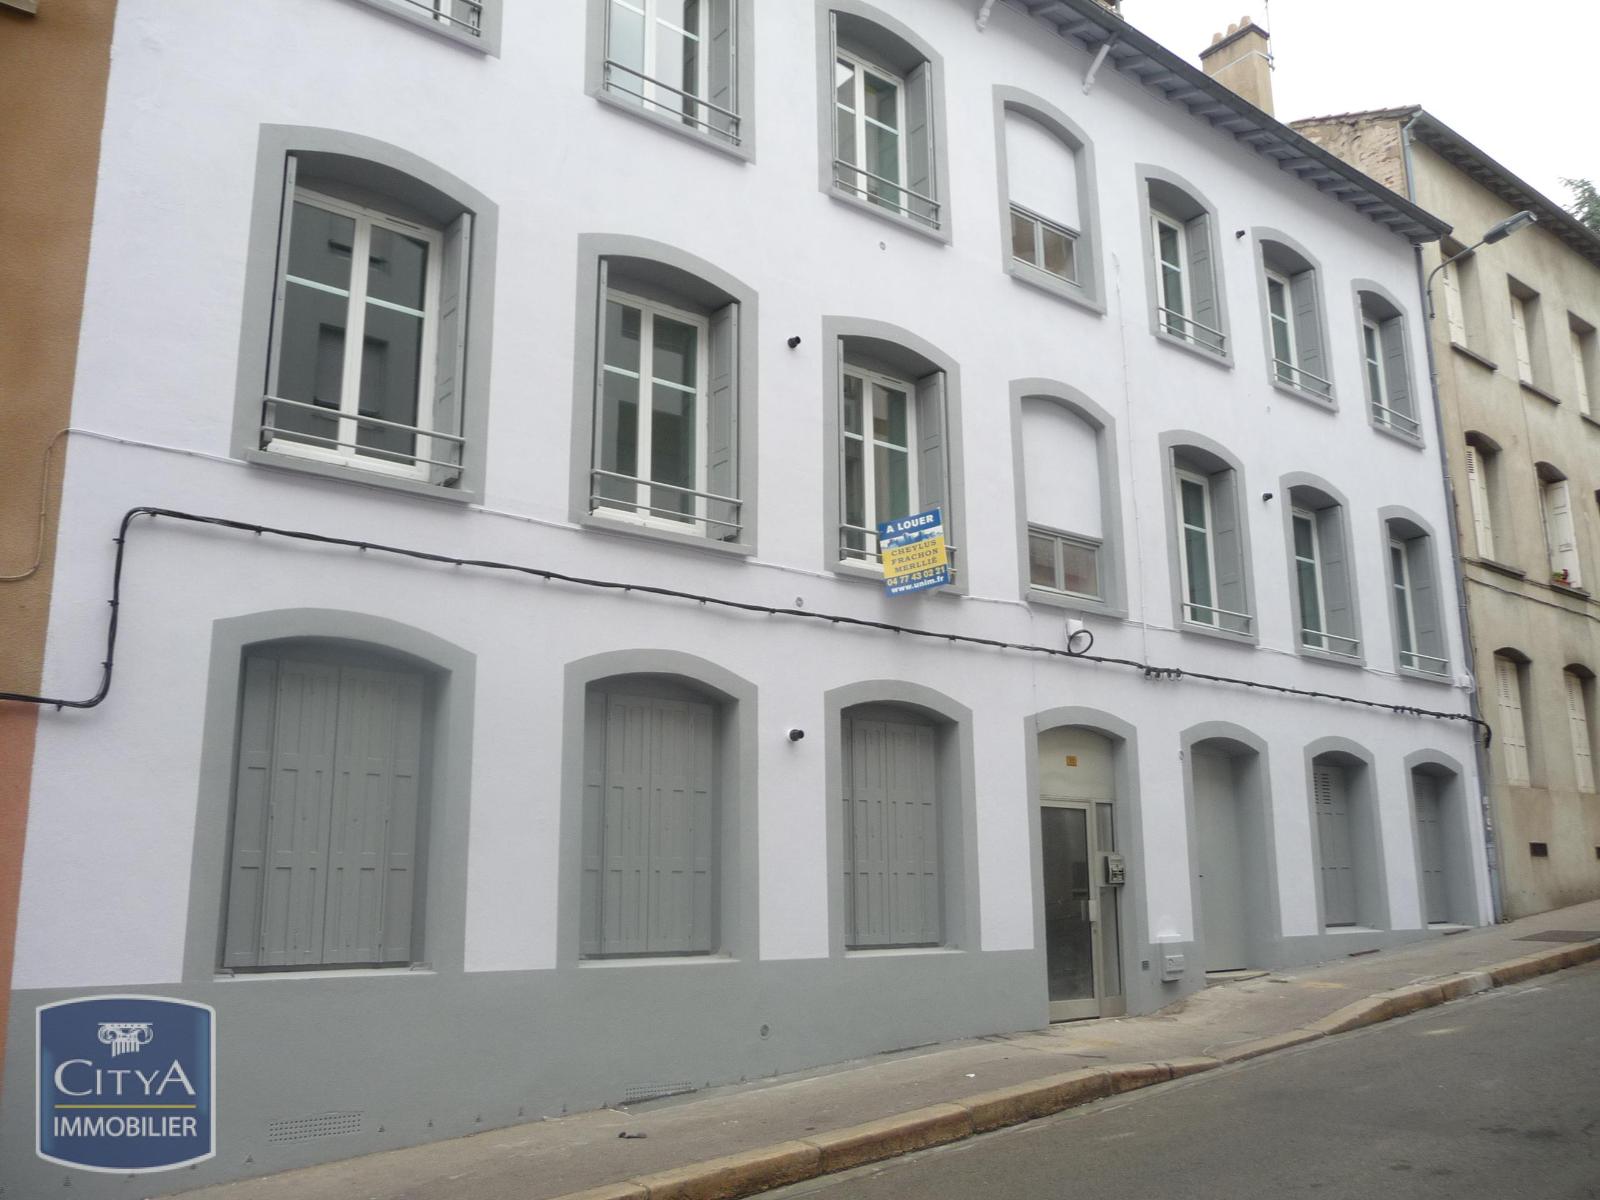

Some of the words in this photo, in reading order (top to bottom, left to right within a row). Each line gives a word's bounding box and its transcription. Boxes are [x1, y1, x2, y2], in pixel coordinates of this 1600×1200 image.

[886, 525, 895, 533] A
[897, 514, 934, 531] LOUER
[891, 539, 937, 556] CHEYLUS
[891, 548, 939, 565] FRACHON
[887, 578, 898, 586] 04
[899, 575, 909, 583] 77
[890, 575, 944, 593] www.unim.fr
